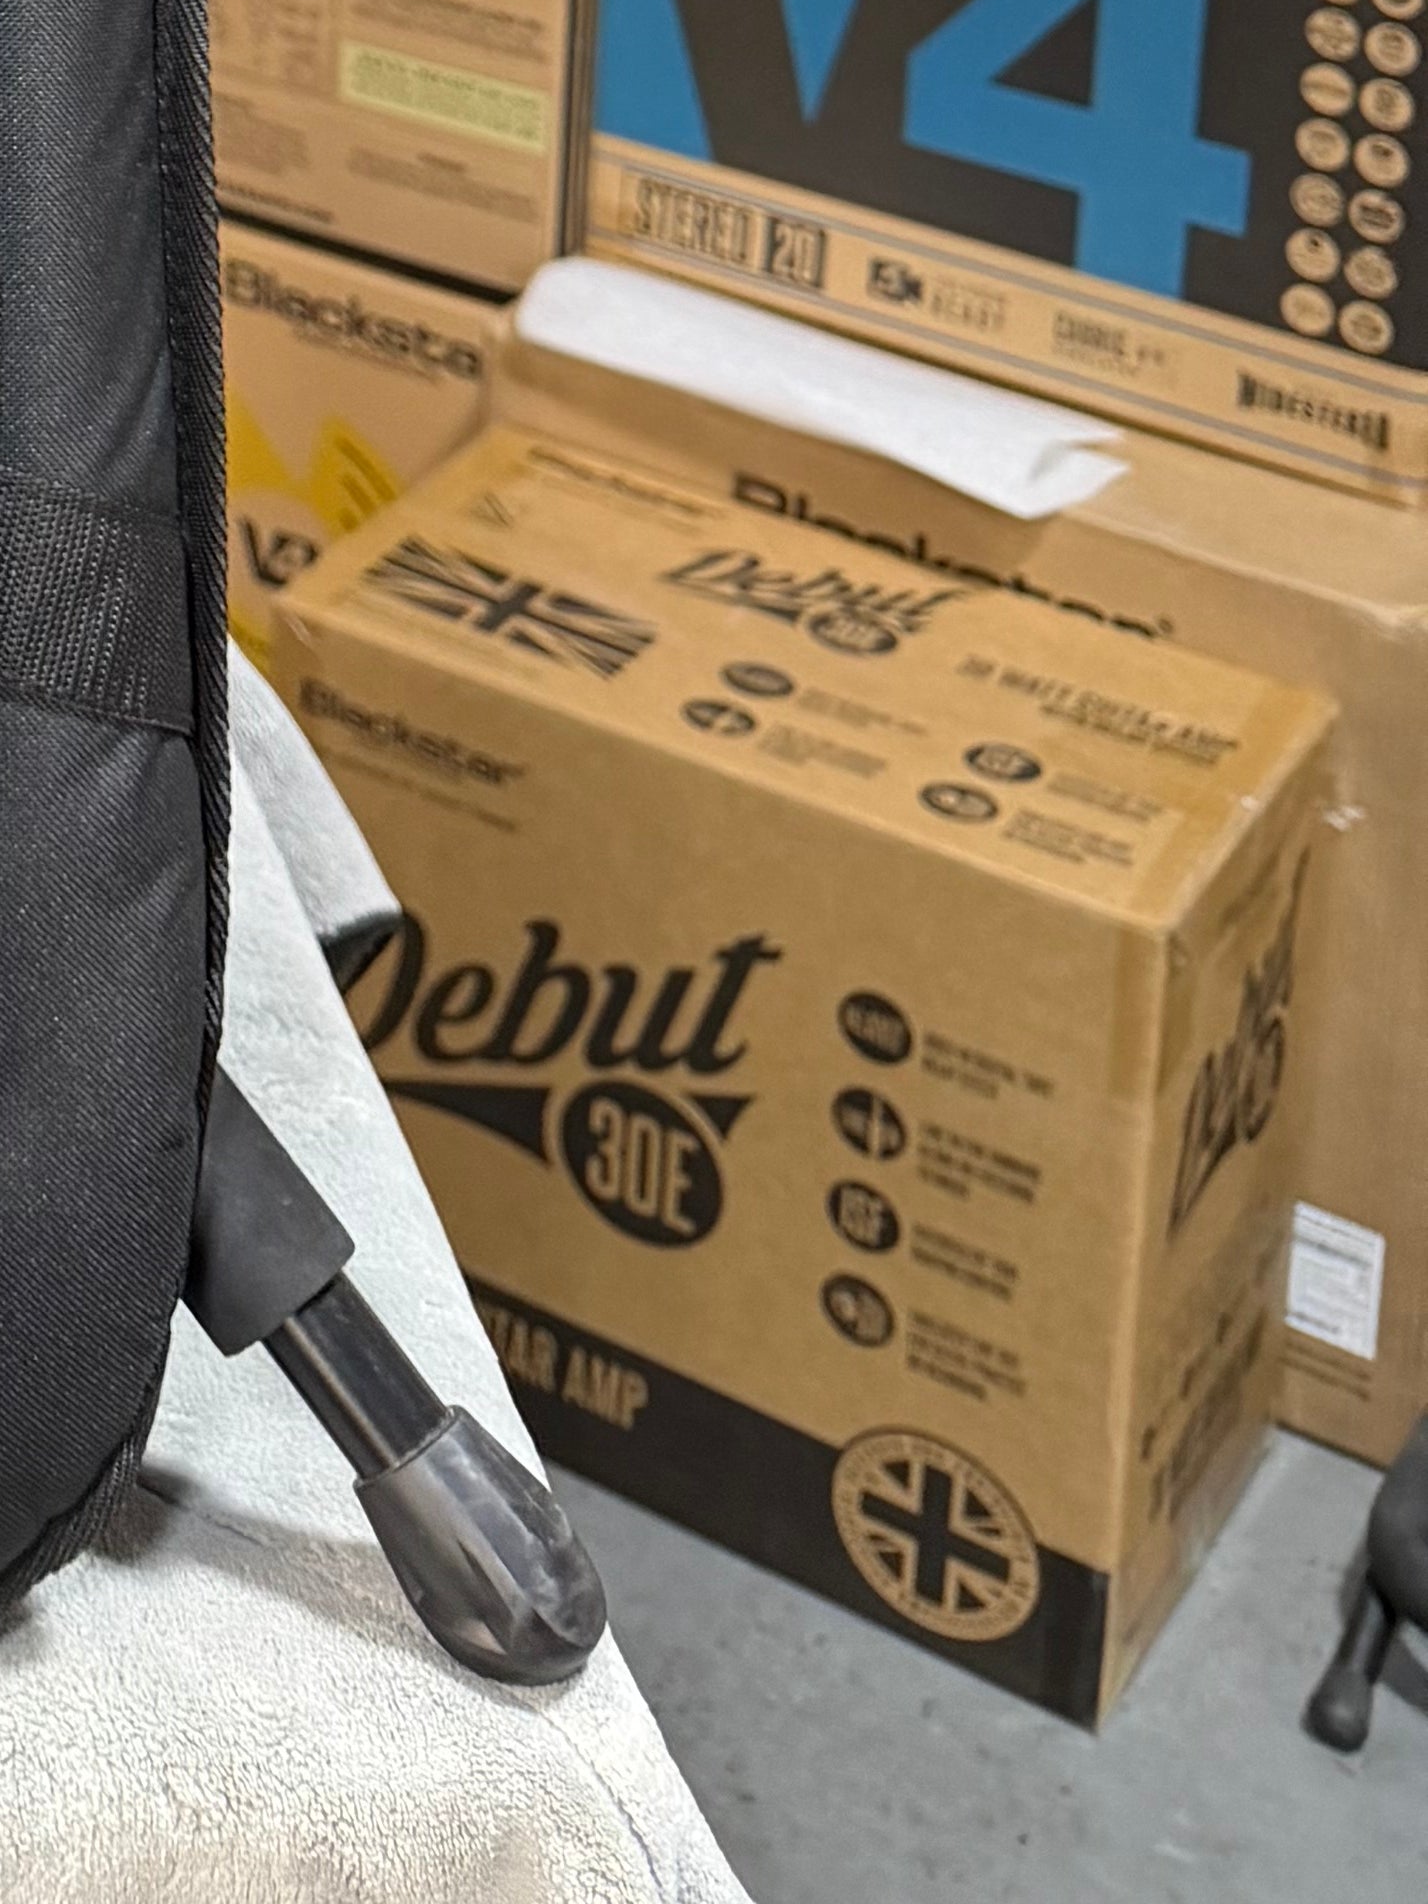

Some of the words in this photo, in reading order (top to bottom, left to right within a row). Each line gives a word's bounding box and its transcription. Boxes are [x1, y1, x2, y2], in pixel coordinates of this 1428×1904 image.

[635, 178, 754, 266] STEREO
[772, 221, 822, 288] 20
[225, 257, 483, 381] Blacksta
[300, 677, 526, 789] Blackstar
[585, 1097, 698, 1237] 30E
[562, 1344, 650, 1431] AMP
